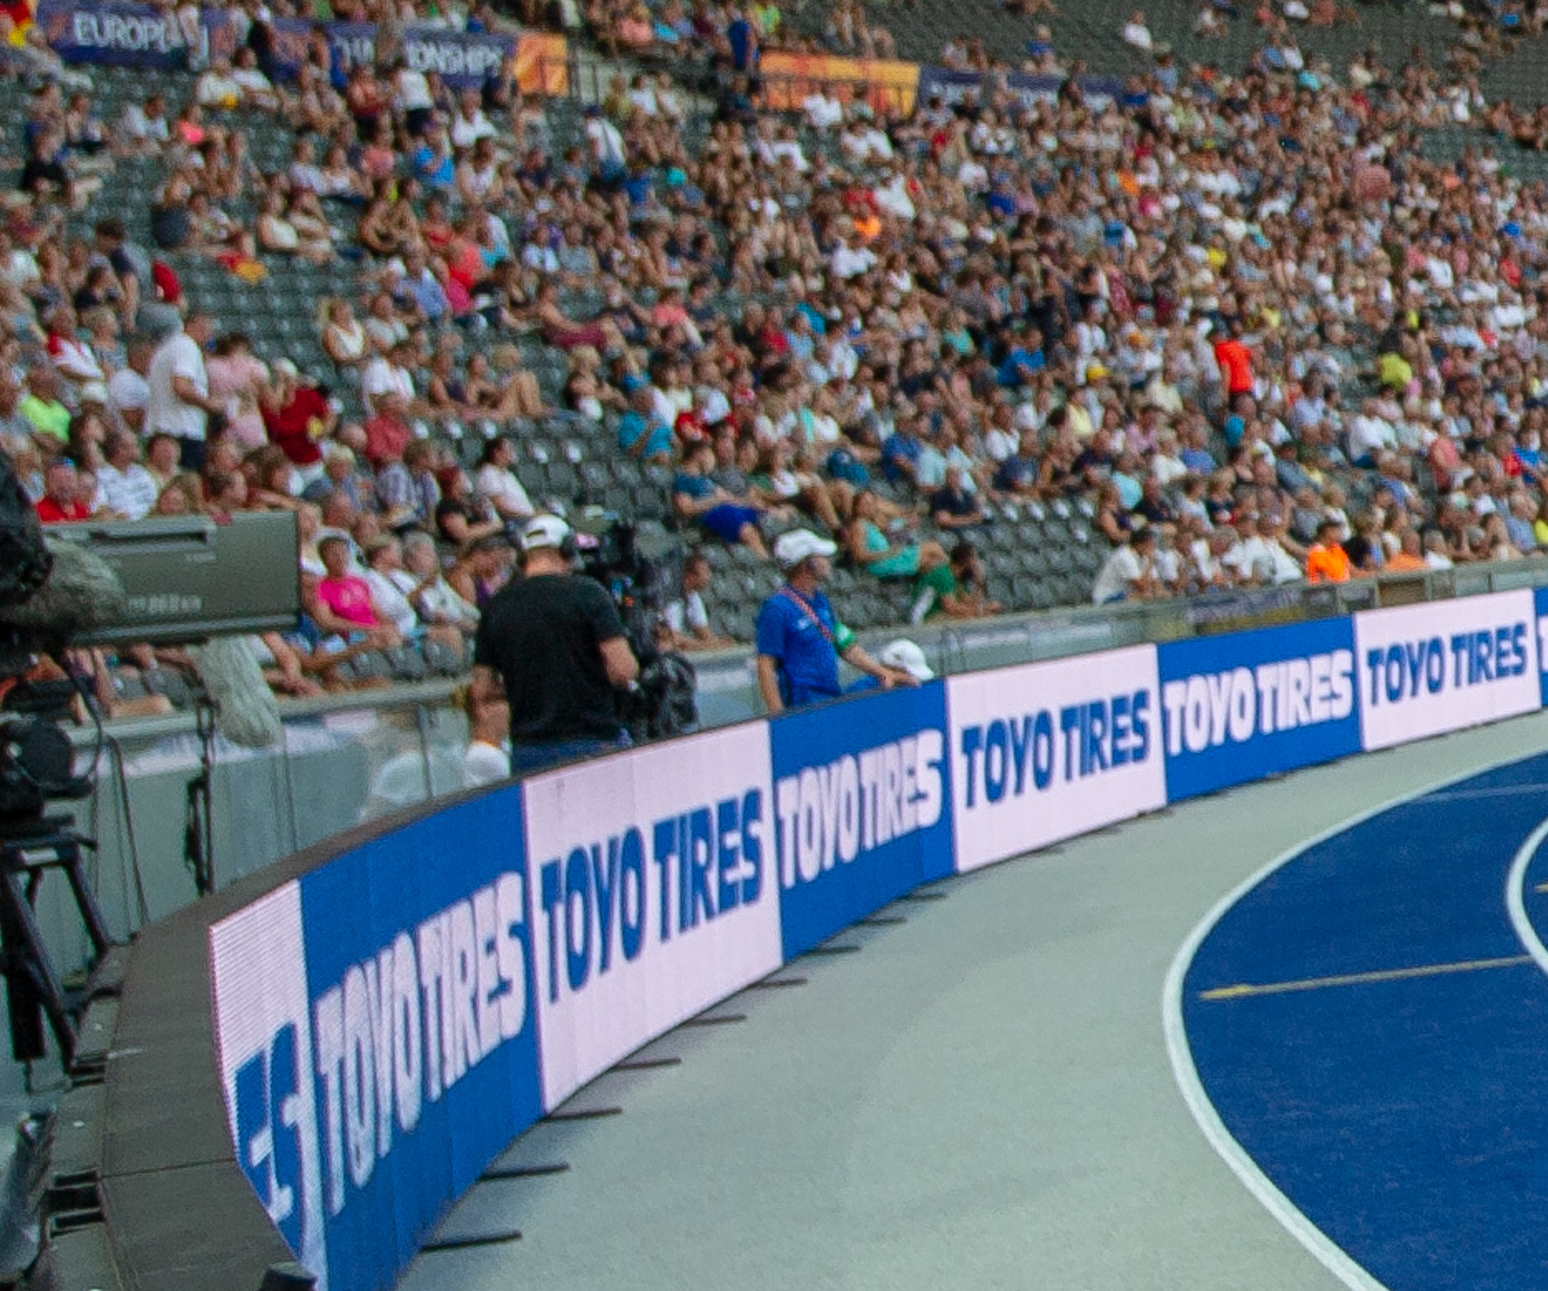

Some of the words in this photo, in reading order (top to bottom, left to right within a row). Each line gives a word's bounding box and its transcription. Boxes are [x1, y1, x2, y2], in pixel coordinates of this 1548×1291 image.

[1163, 665, 1256, 757] TOYO
[1255, 648, 1354, 736] TIRES
[1367, 638, 1446, 705] TOYO
[1451, 621, 1527, 688] TIRES
[776, 753, 859, 890] TOYO
[858, 728, 943, 852] TIRES
[962, 709, 1054, 809] TOYO
[1059, 688, 1152, 782] TIRES
[539, 825, 647, 1005] TOYO
[653, 787, 764, 946] TIRES
[315, 930, 424, 1218] TOYO
[416, 870, 530, 1104] TIRES
